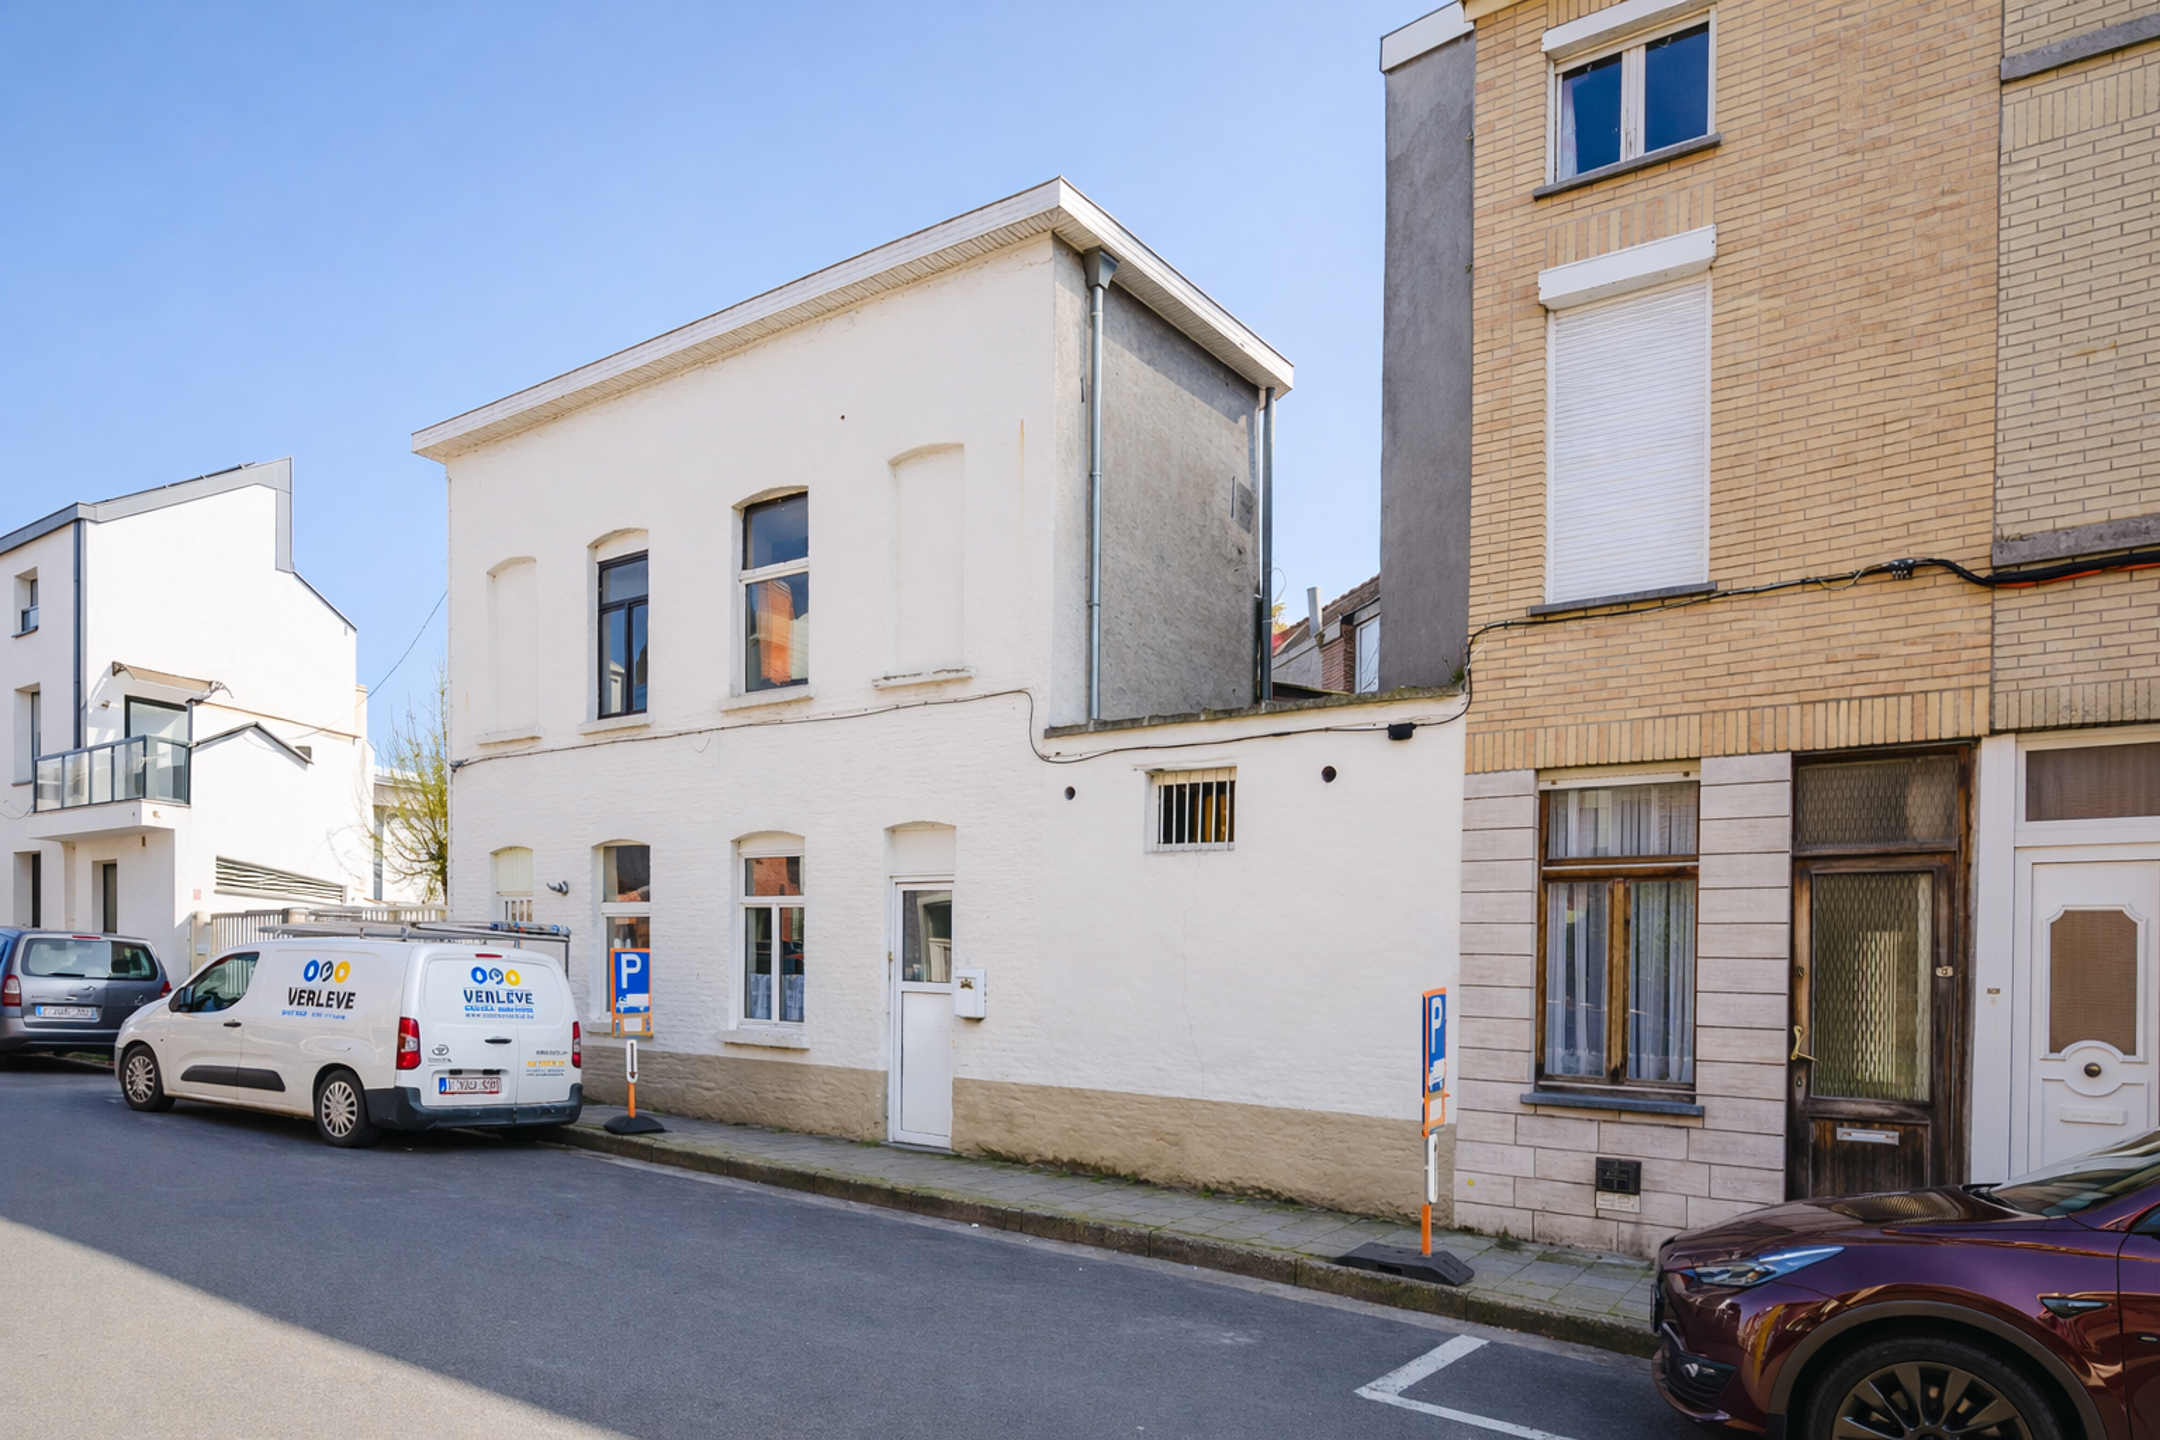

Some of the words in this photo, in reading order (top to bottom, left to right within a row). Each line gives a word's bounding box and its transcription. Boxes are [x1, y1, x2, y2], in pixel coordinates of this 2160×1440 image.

[620, 953, 642, 989] P
[288, 987, 356, 1009] VERLEVE
[1431, 997, 1443, 1053] P
